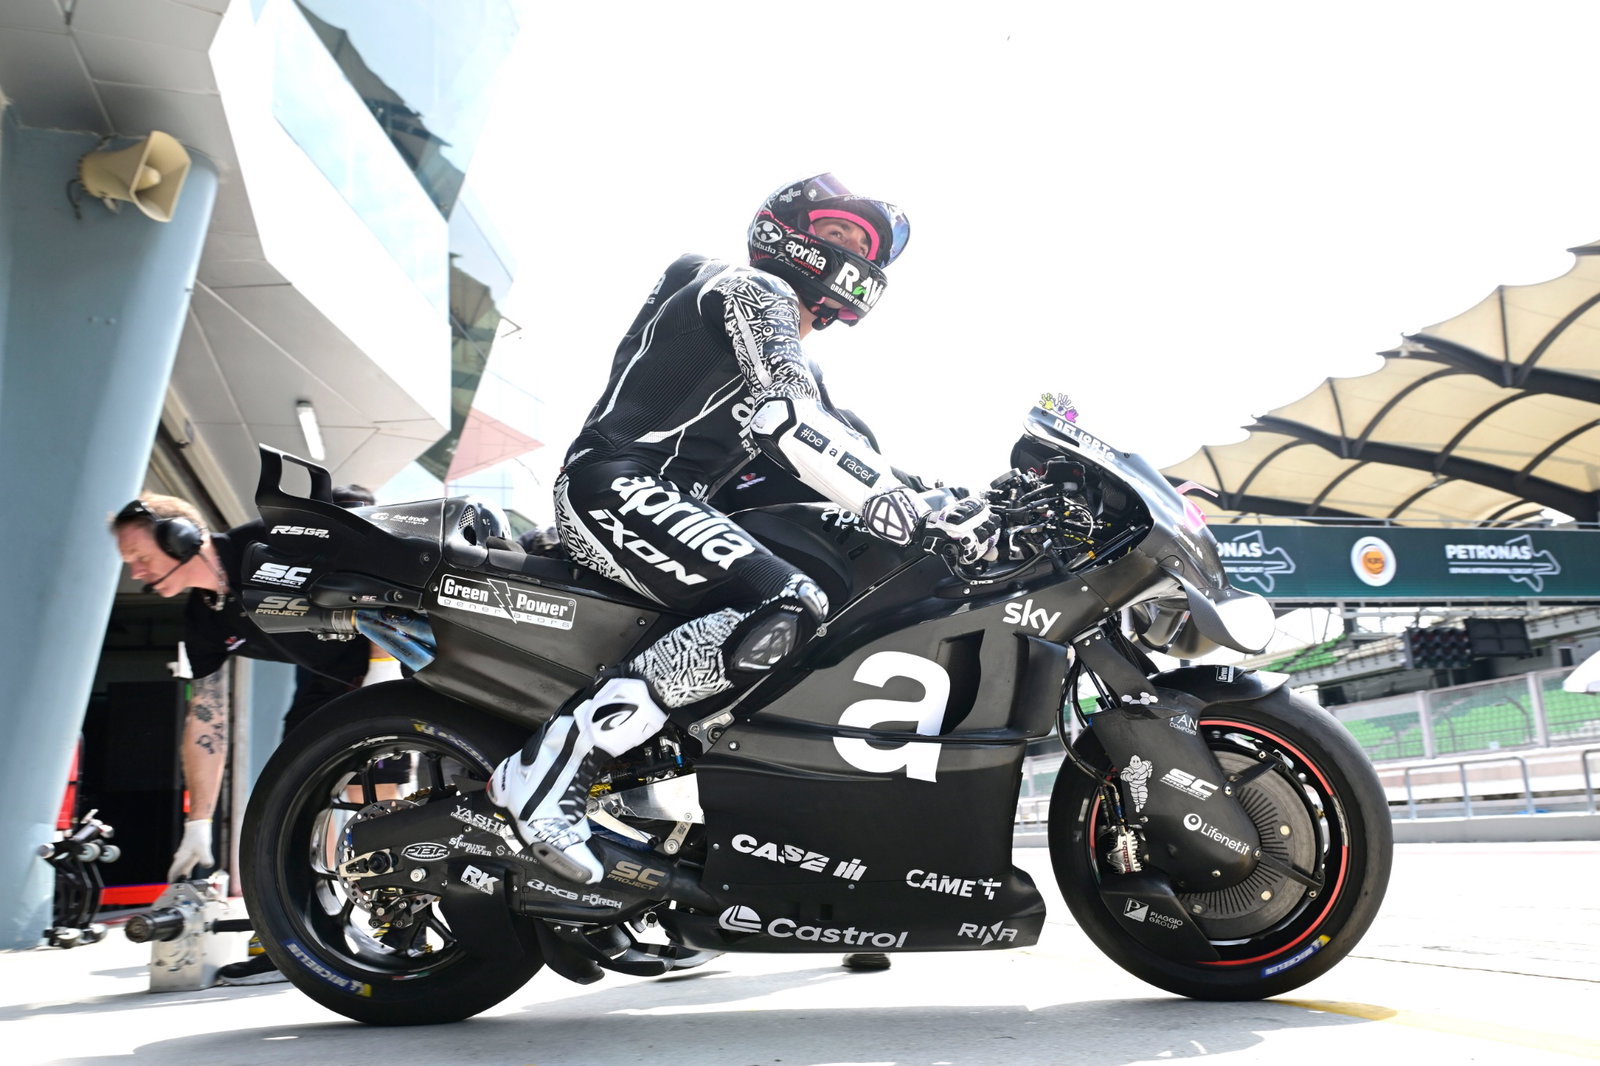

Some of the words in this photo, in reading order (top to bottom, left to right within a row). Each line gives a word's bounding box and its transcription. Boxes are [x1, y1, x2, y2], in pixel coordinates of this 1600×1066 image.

[785, 240, 827, 271] aprilia
[800, 427, 824, 447] #be
[829, 447, 838, 458] a
[843, 457, 875, 481] racer
[610, 475, 756, 570] aprilia
[588, 508, 708, 586] IXON
[1445, 544, 1533, 560] PETRONAS
[255, 562, 313, 581] SC
[258, 595, 310, 612] SC
[443, 578, 489, 602] Green
[516, 593, 568, 616] Power
[255, 608, 308, 617] PROJECT
[1002, 599, 1062, 637] sky
[832, 650, 951, 783] a
[1200, 822, 1251, 856] Lifenet.it
[731, 834, 830, 873] CASE
[461, 864, 500, 890] RK
[606, 873, 657, 891] PROJECT
[611, 860, 666, 886] SC
[544, 885, 579, 901] RCB
[582, 893, 622, 909] FÖRCH
[1149, 917, 1178, 930] GROUP
[1150, 911, 1183, 926] PIAGGIO
[767, 917, 909, 948] Castrol
